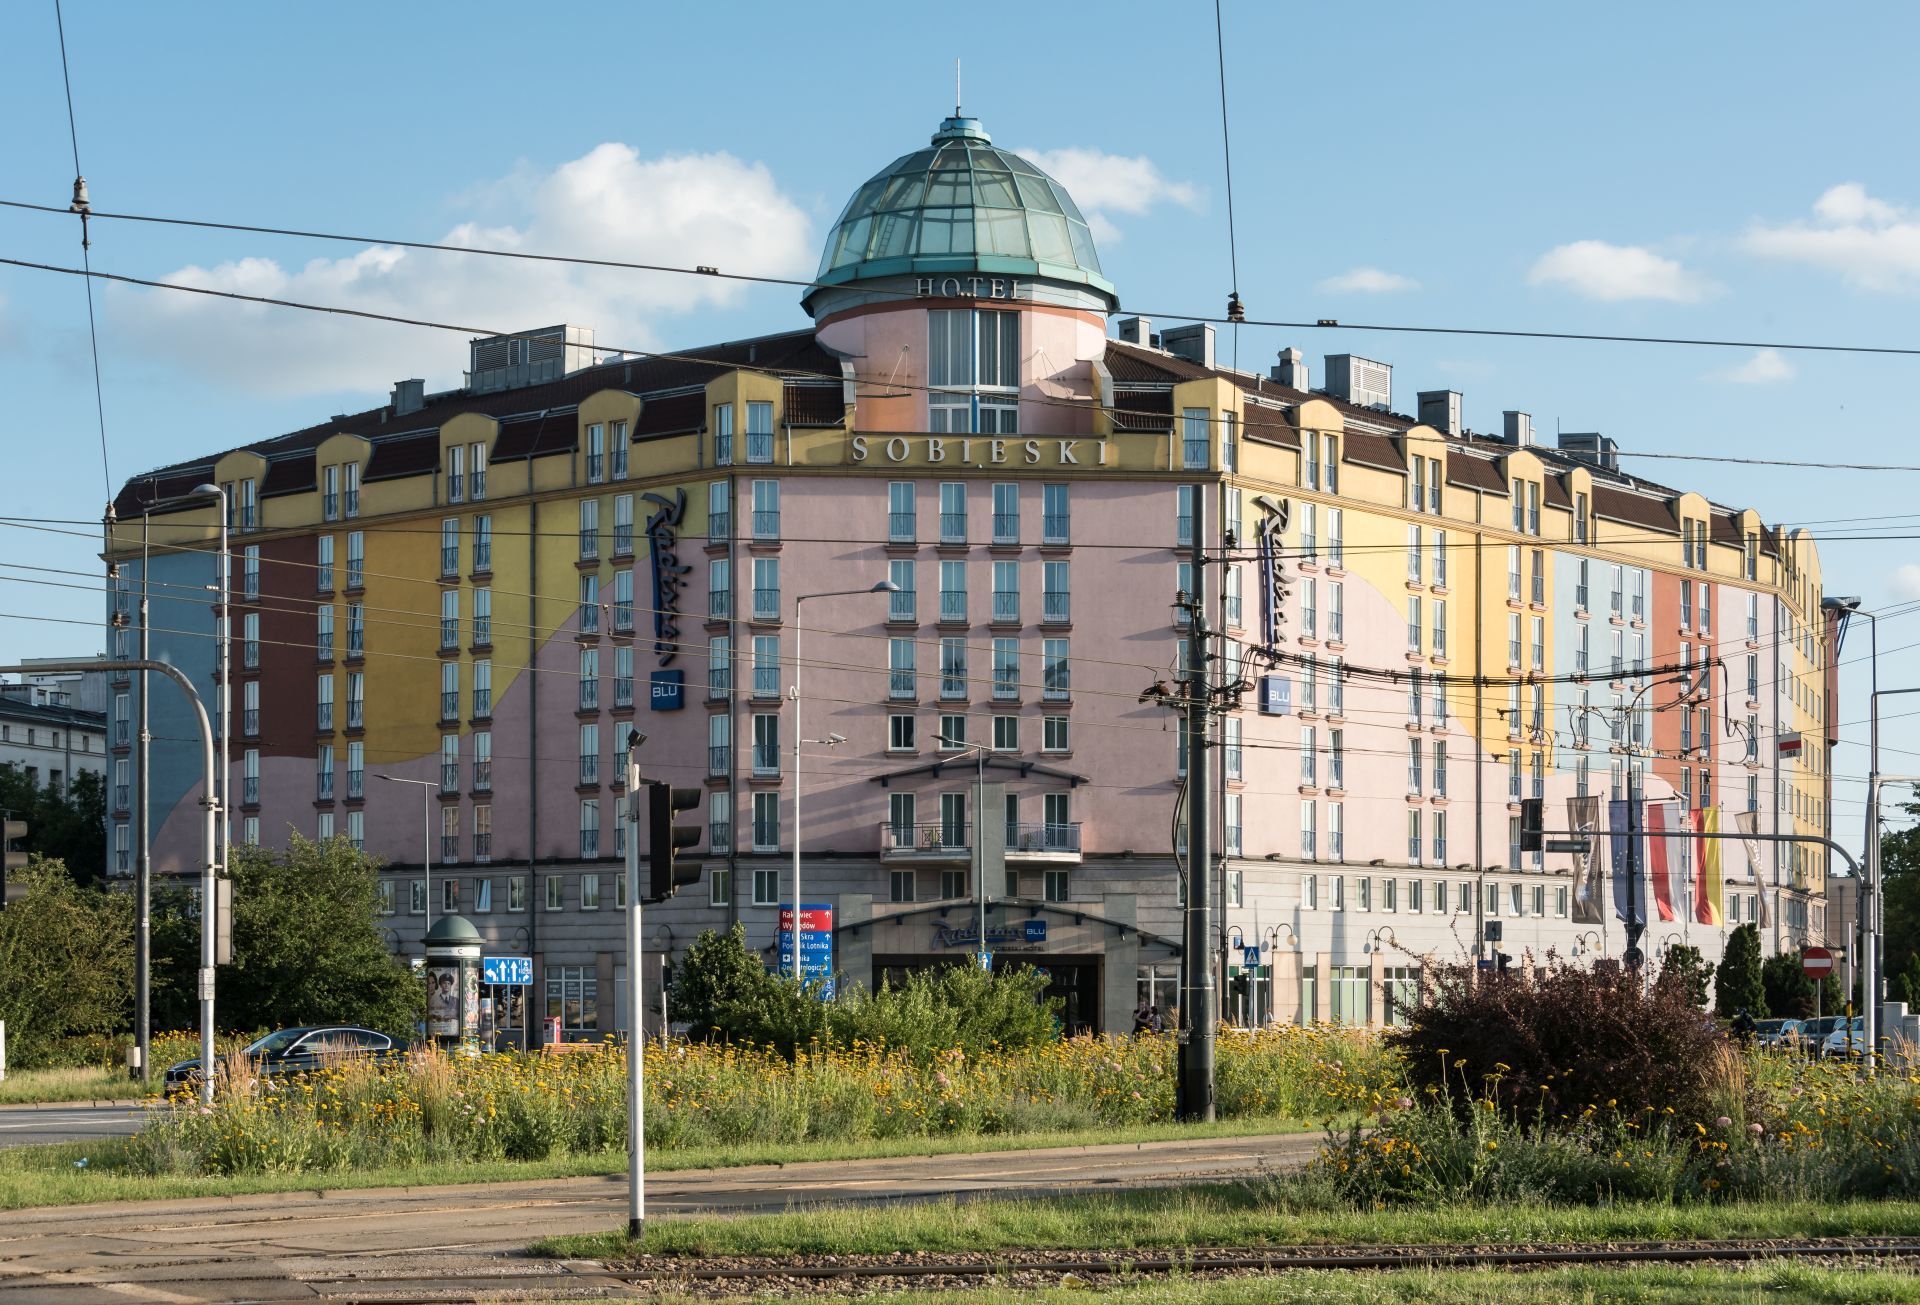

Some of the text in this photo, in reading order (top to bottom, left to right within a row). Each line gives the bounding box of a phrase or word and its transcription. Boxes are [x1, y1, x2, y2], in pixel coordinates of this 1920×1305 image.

[915, 277, 1026, 300] HOTEL
[852, 435, 1106, 465] SOBIESKI
[652, 683, 678, 698] BLU
[1269, 689, 1290, 702] BLU
[782, 911, 812, 919] Rakwiec
